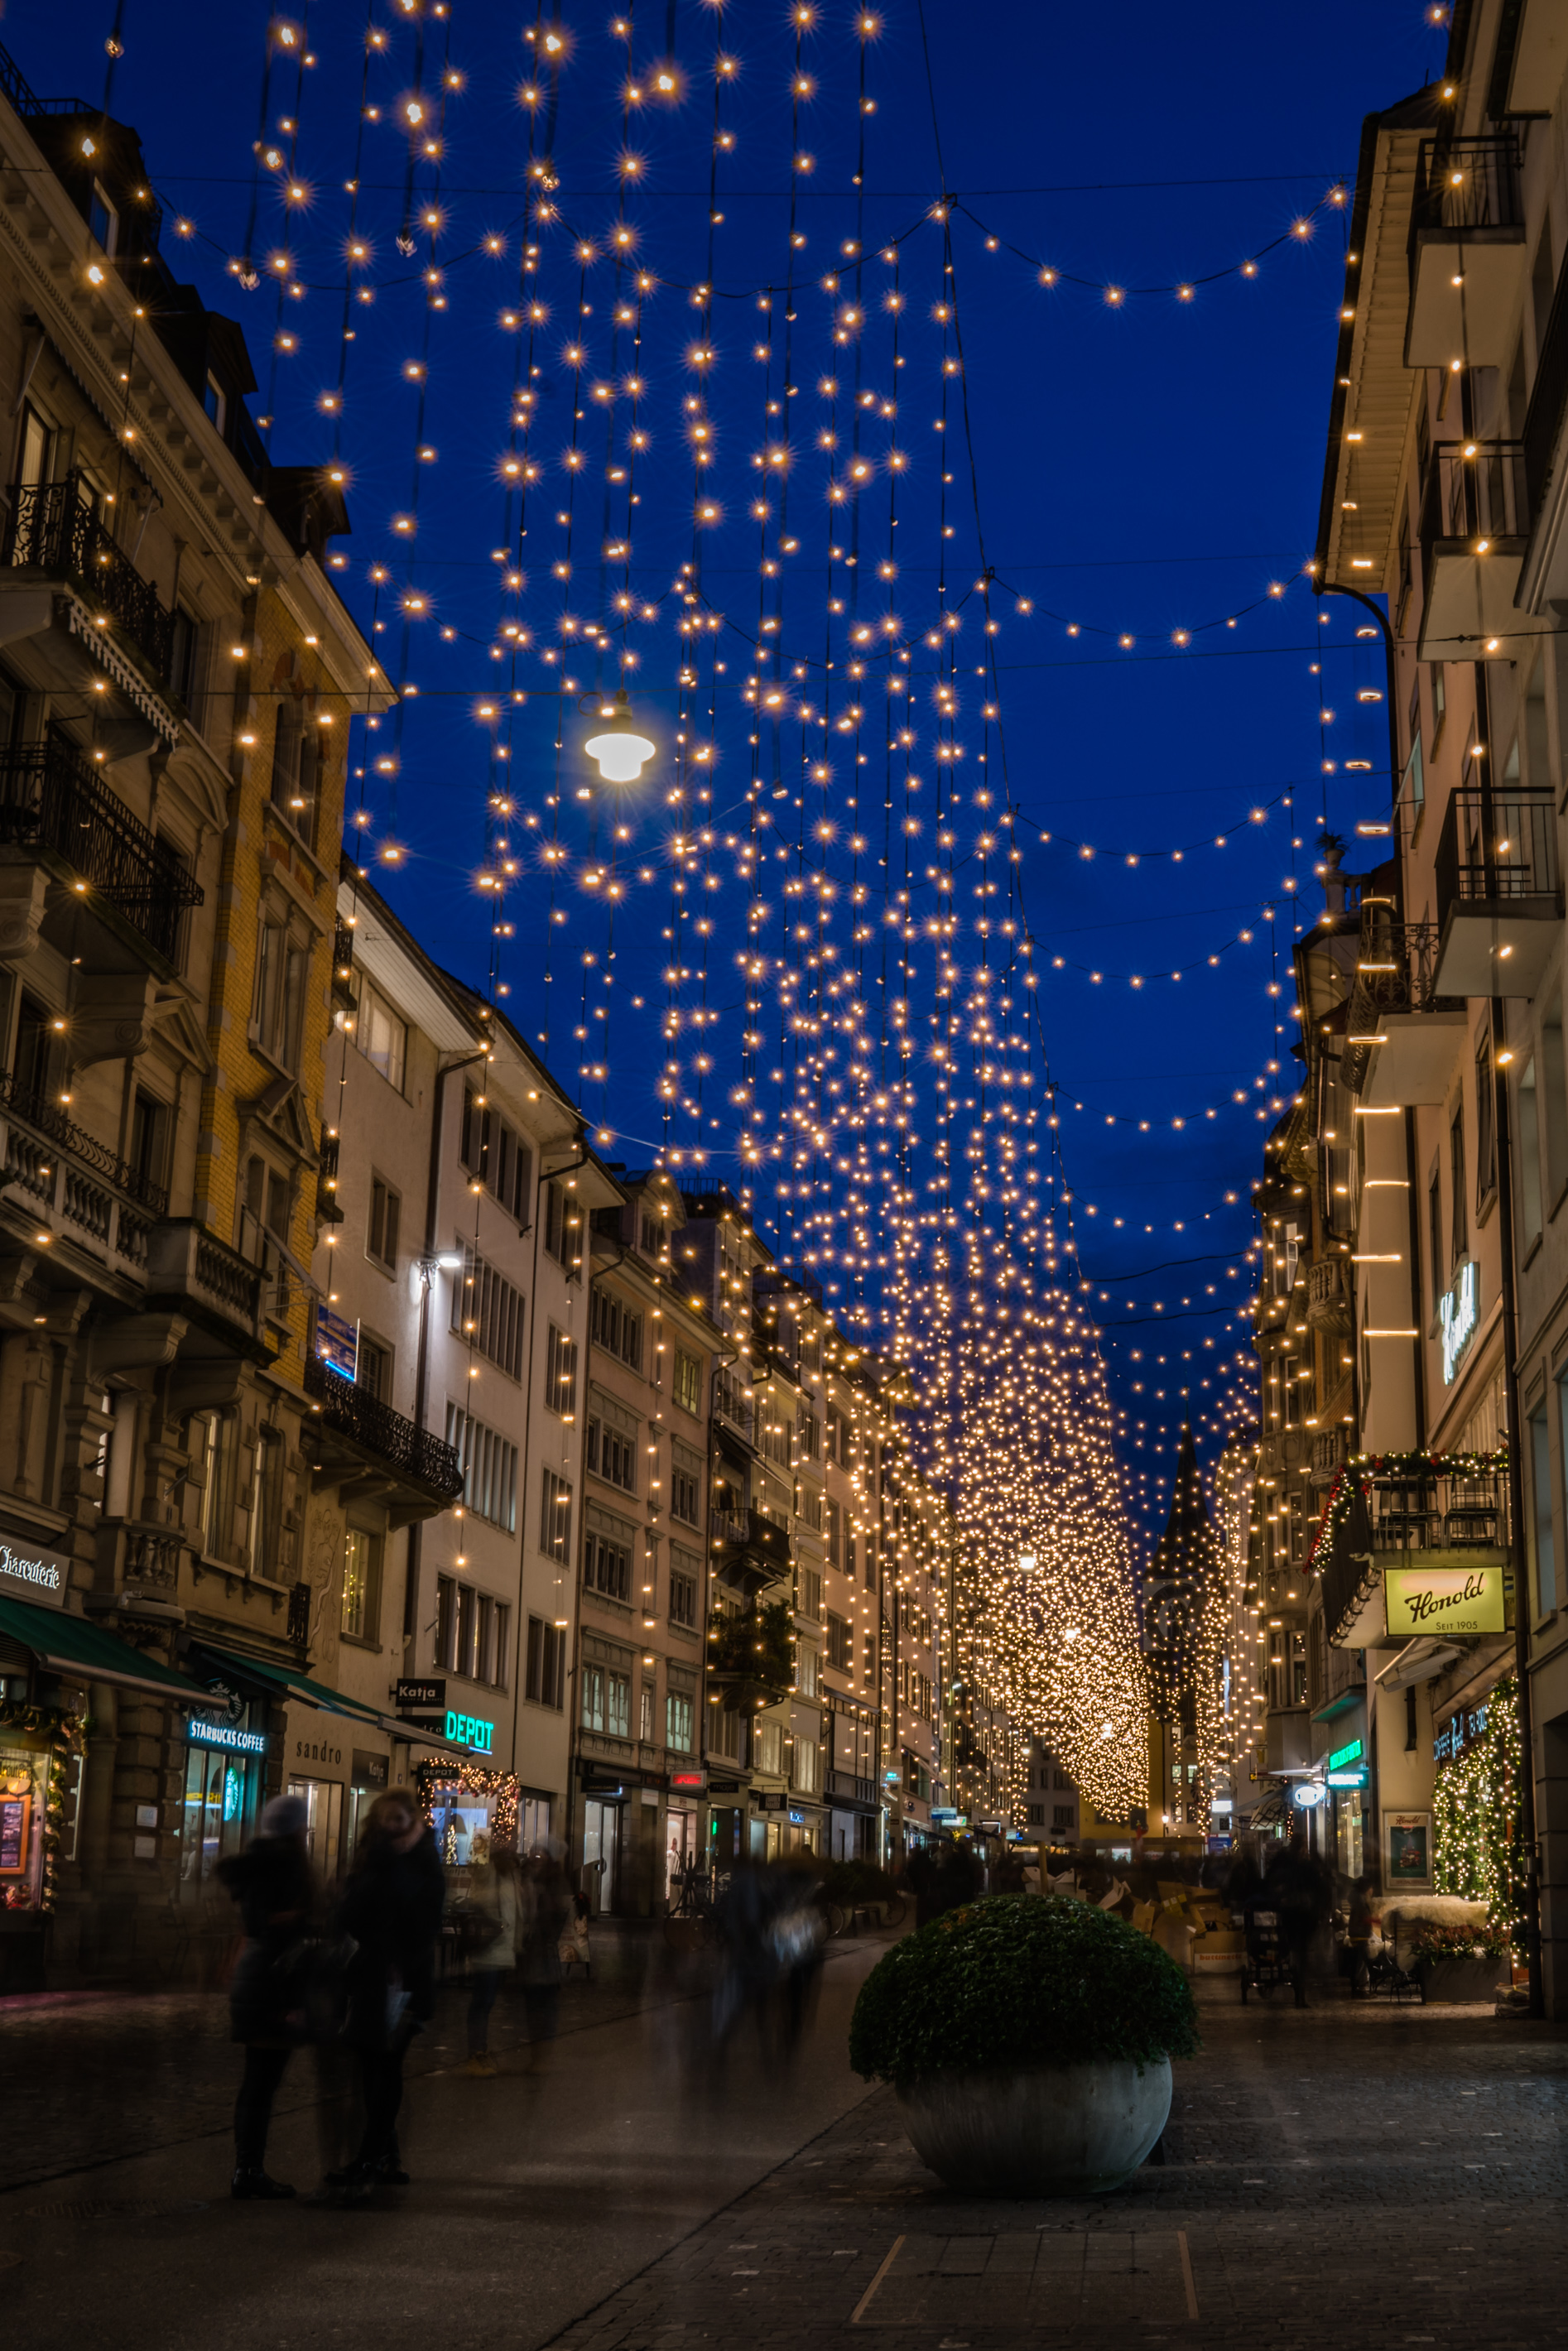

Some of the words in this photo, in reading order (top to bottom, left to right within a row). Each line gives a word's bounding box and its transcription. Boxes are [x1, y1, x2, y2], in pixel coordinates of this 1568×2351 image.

[0, 1545, 60, 1589] Charcuterie
[1404, 1571, 1484, 1624] Honold
[1436, 1622, 1454, 1631] SEIT
[1456, 1621, 1478, 1630] 1905
[398, 1685, 436, 1702] Katja
[191, 1720, 237, 1747] STARBUCKS
[237, 1731, 265, 1752] COFFEE
[445, 1710, 494, 1750] DEPOT
[296, 1740, 342, 1765] sandro
[368, 1762, 384, 1783] Katja
[422, 1768, 454, 1776] DEPOT
[672, 1773, 702, 1785] BREE
[713, 1783, 735, 1792] maje
[1395, 1815, 1421, 1825] Honold
